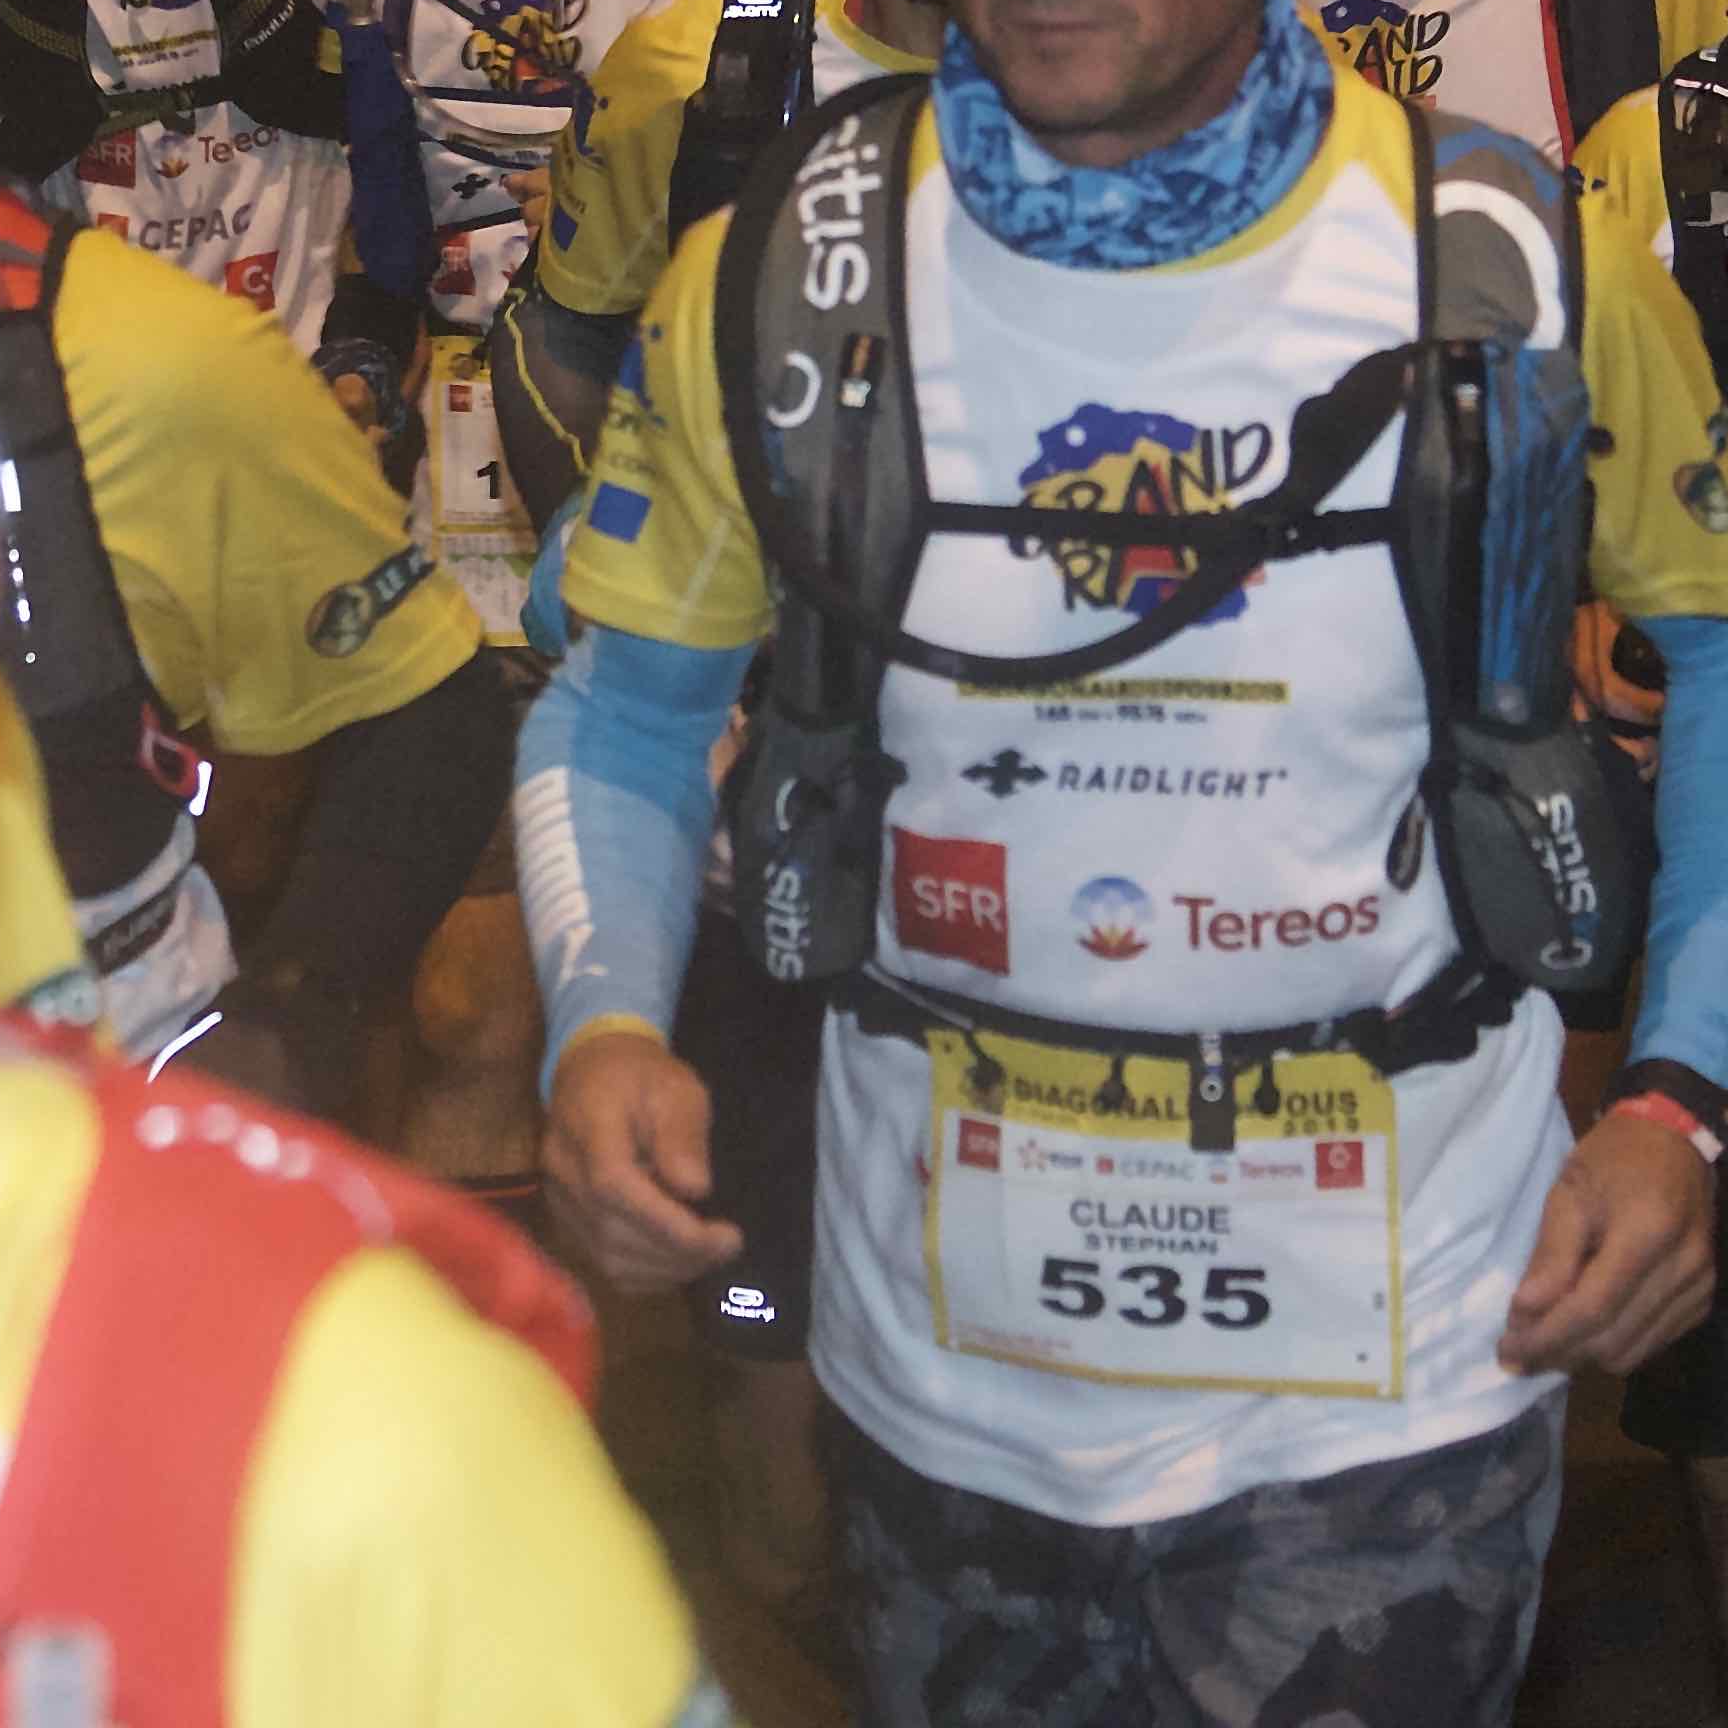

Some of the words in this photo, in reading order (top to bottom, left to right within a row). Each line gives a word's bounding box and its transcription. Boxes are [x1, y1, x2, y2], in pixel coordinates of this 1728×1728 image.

[138, 203, 253, 252] CEPAC
[1057, 764, 1287, 799] RAIDLIGHT
[911, 875, 1004, 932] SFR
[1172, 893, 1381, 952] Tereos
[1284, 1088, 1360, 1118] OUS
[1068, 1199, 1231, 1236] CLAUDE
[1084, 1233, 1219, 1256] STEPHAN
[1039, 1255, 1271, 1330] 535
